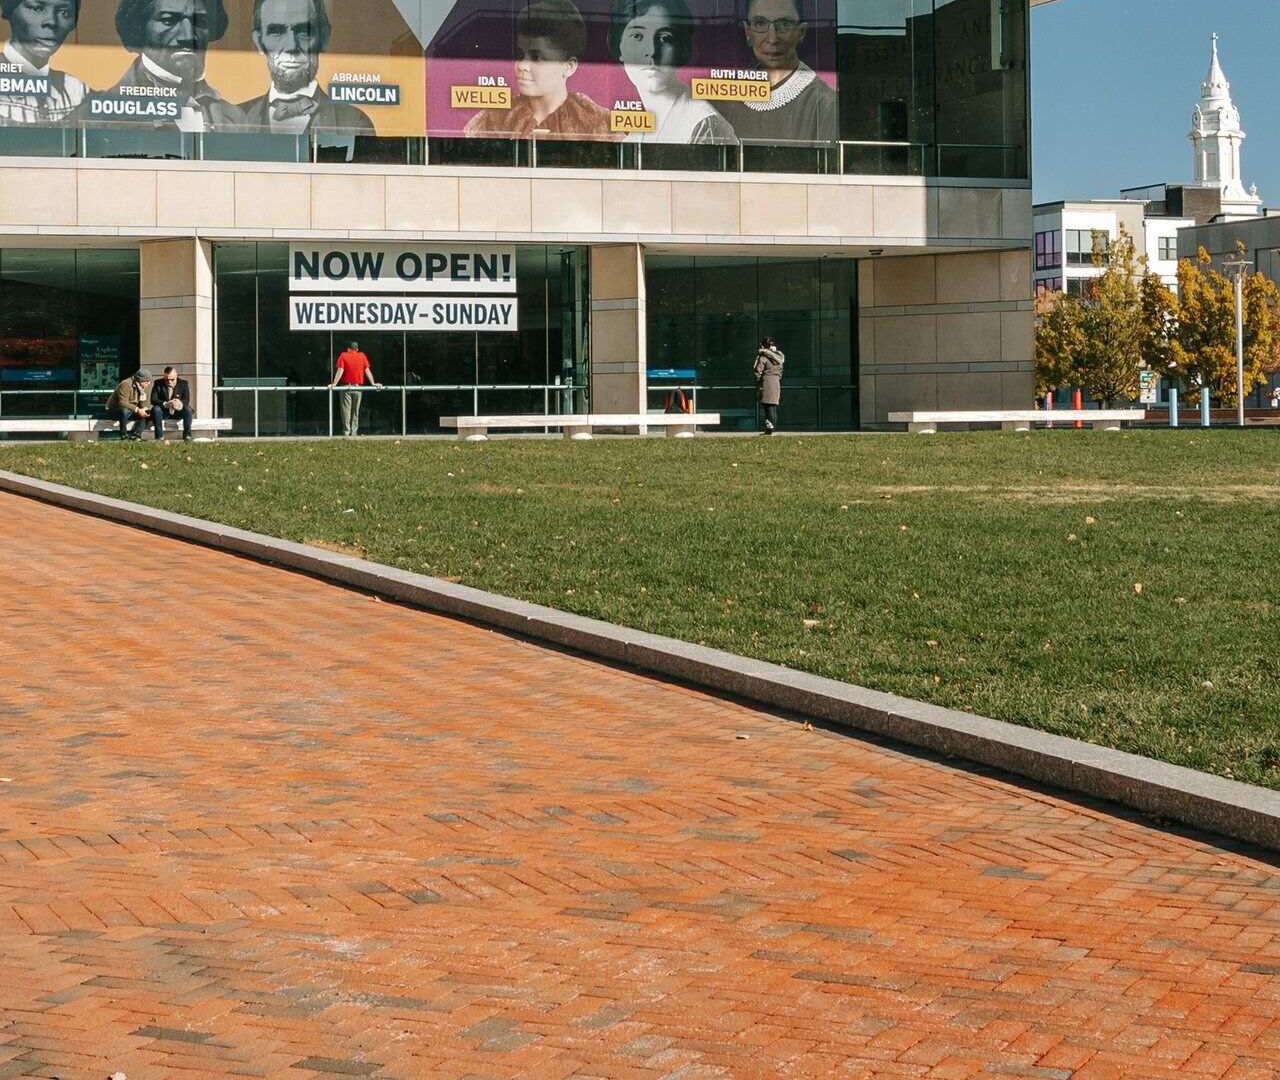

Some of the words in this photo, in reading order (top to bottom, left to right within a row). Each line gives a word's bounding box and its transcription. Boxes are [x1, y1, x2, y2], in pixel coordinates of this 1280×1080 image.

[332, 72, 381, 83] ABRAHAM
[477, 75, 496, 86] IDA
[498, 75, 507, 86] B.
[710, 69, 735, 80] RUTH
[737, 70, 768, 81] BADER
[119, 85, 178, 97] FREDERICK
[331, 85, 397, 102] LINCOLN
[455, 90, 507, 105] WELLS
[695, 83, 768, 98] GINSBURG
[91, 99, 178, 117] DOUGLASS
[614, 100, 642, 111] ALICE
[614, 115, 652, 129] PAUL
[294, 251, 385, 281] NOW
[395, 252, 511, 282] OPEN!
